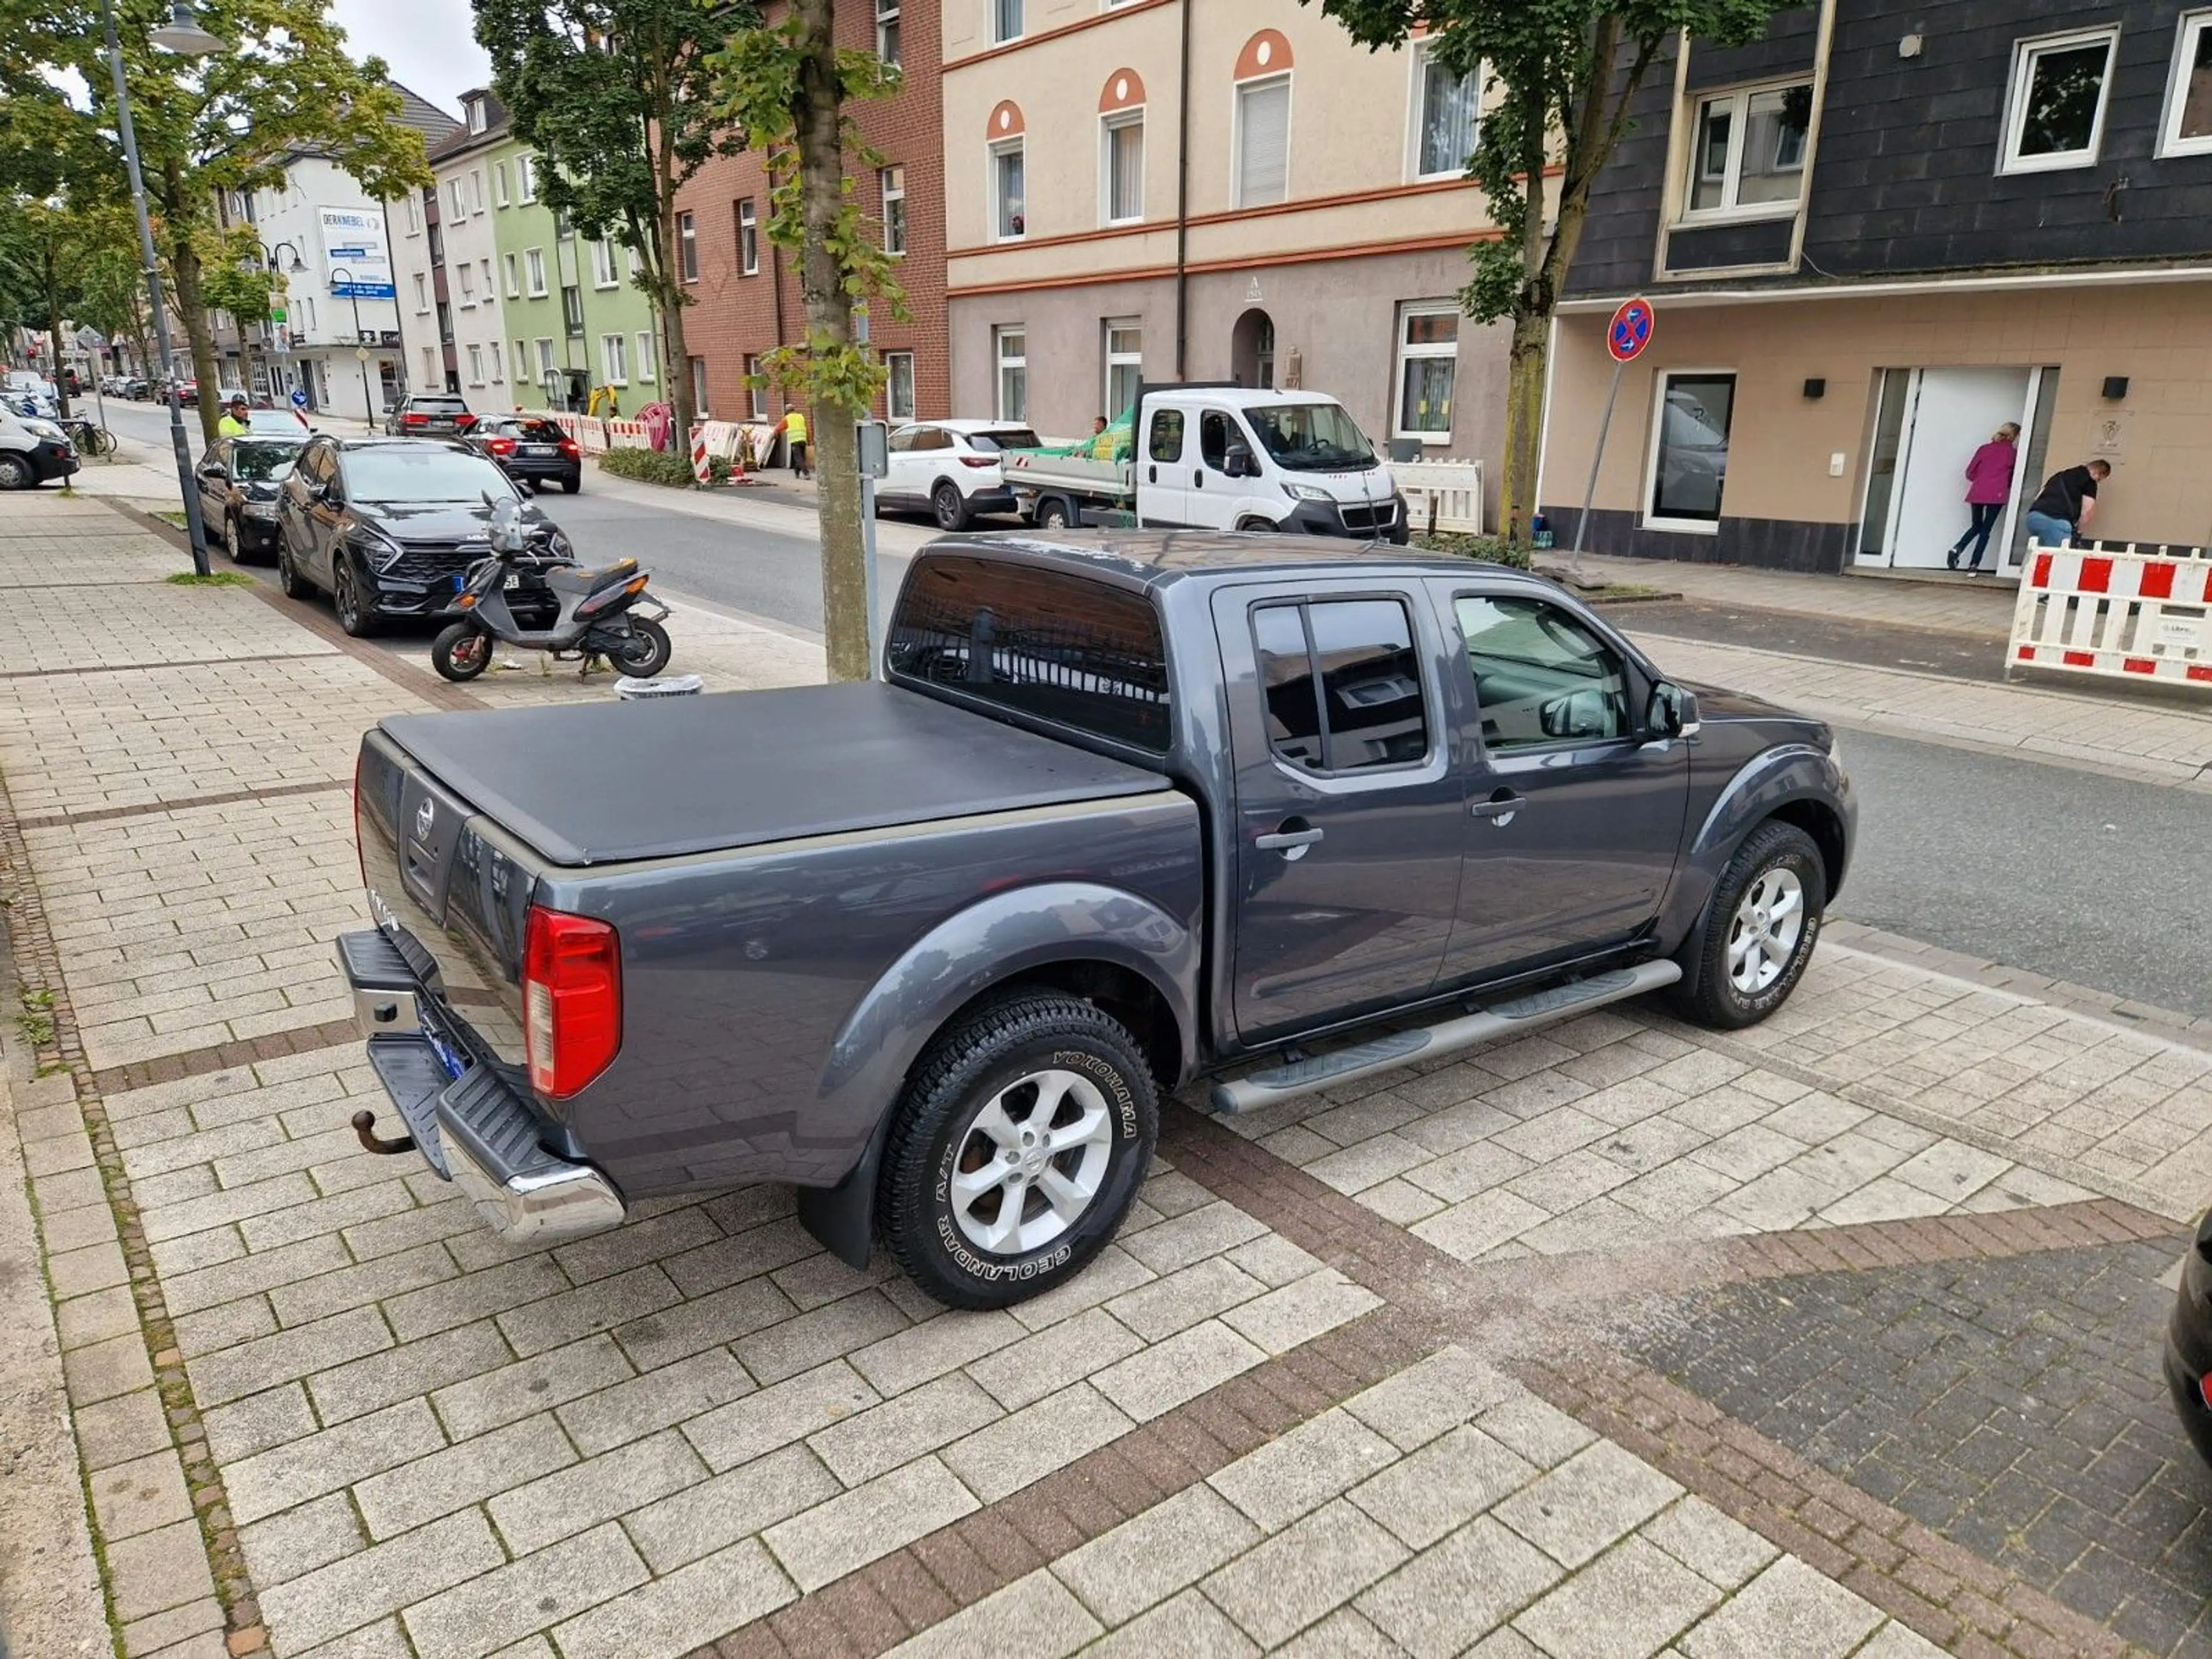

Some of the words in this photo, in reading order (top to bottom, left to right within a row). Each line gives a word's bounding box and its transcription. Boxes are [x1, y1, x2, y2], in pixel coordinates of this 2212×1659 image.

[1052, 1050, 1137, 1138] YOKOHAMA
[935, 1143, 954, 1203] A/T
[937, 1214, 1071, 1282] GEOLANDAR
